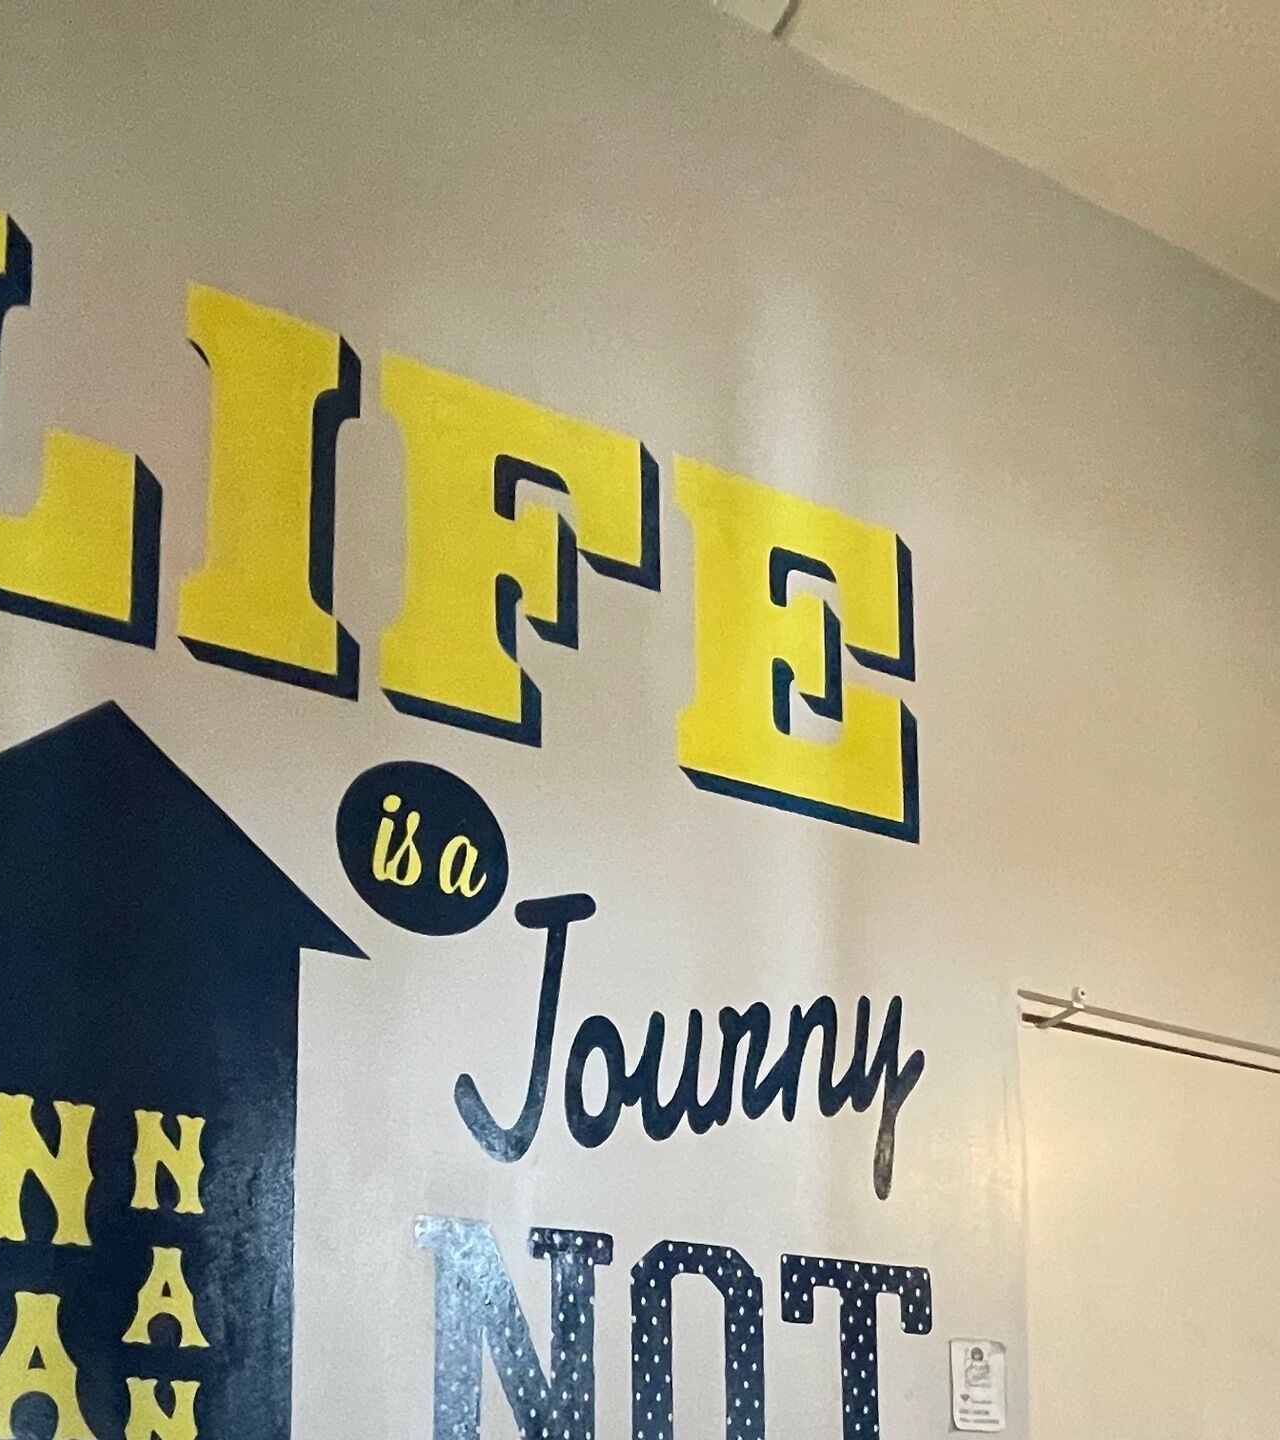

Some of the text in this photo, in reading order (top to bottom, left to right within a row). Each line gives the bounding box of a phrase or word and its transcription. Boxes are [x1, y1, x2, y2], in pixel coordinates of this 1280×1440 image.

[372, 794, 488, 898] is a
[454, 892, 925, 1201] Journy
